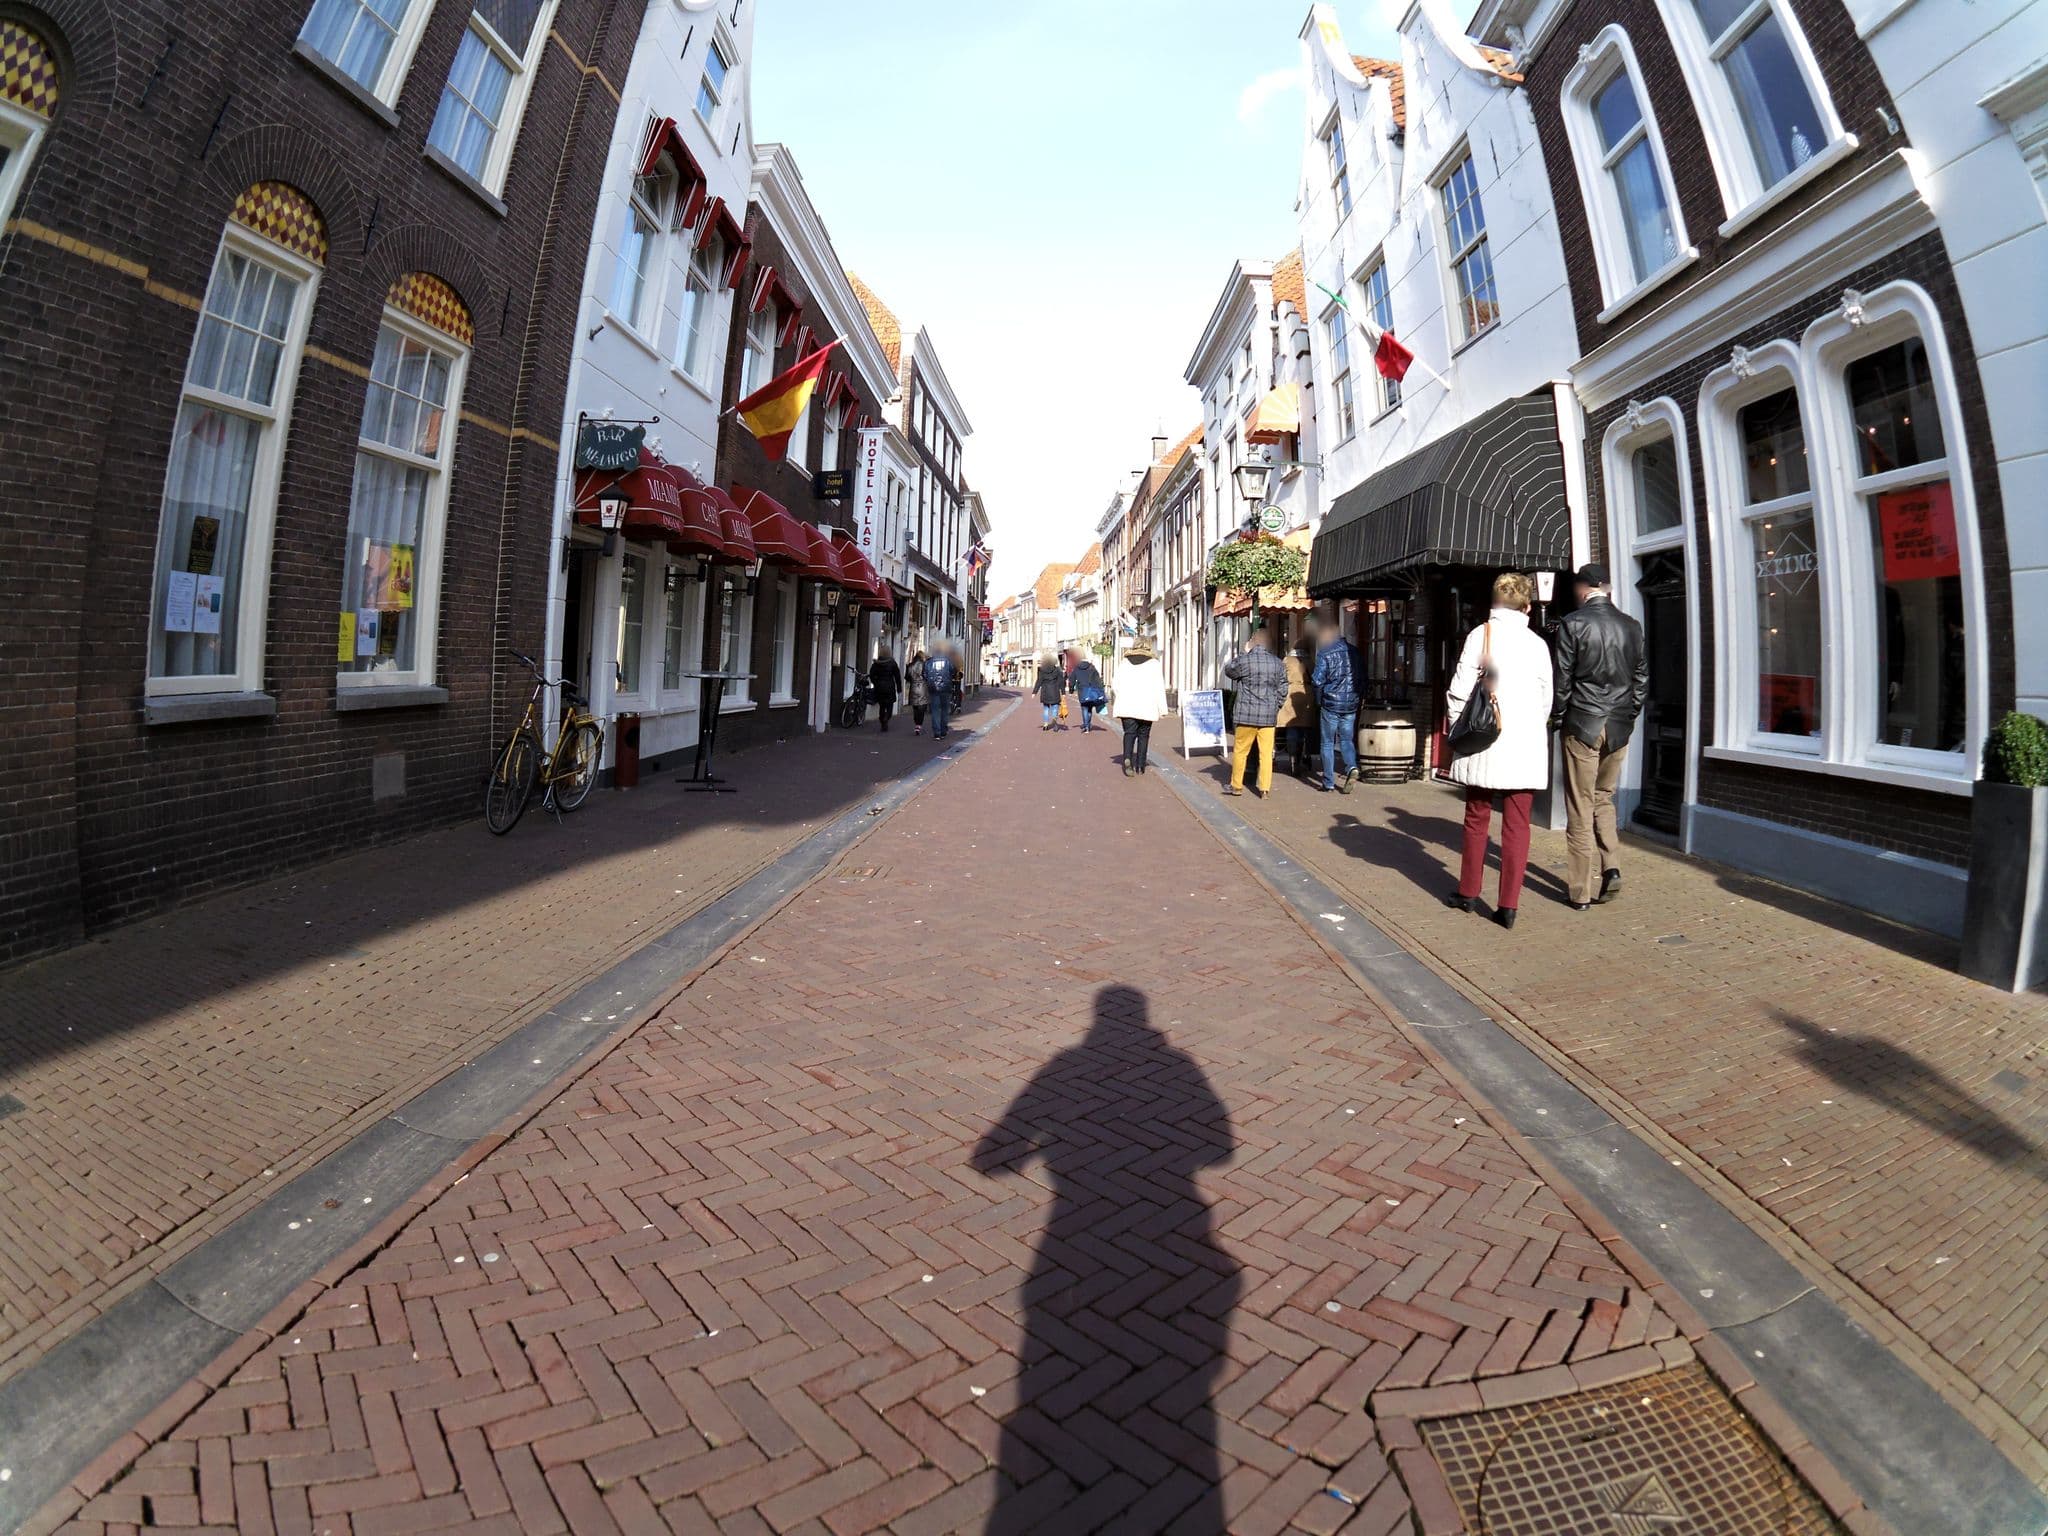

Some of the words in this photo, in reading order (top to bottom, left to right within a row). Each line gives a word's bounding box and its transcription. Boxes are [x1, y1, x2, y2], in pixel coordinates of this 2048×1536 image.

[597, 428, 626, 443] BAR
[866, 437, 878, 489] HOTEL
[862, 494, 874, 547] ATLAS
